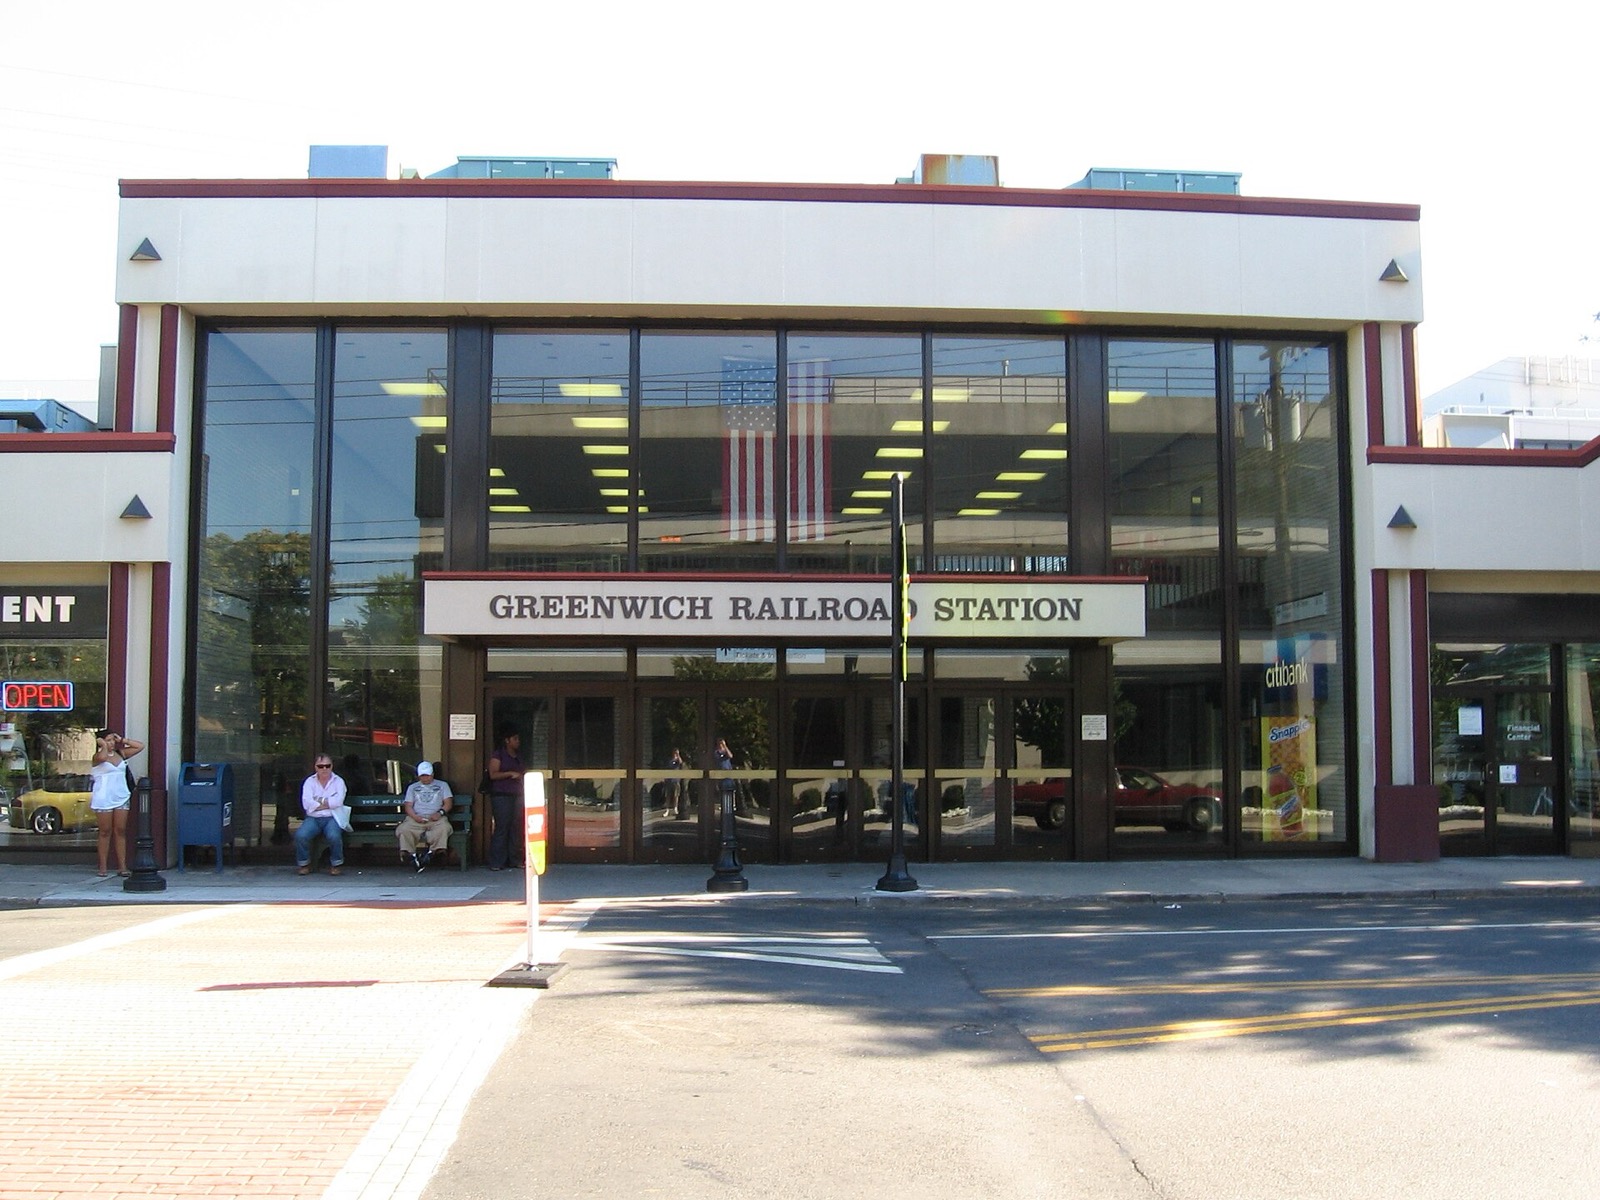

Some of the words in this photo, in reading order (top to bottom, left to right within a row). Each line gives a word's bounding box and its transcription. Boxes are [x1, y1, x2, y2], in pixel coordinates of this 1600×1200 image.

[2, 596, 76, 622] ENT
[489, 595, 713, 619] GREENWICH
[934, 598, 1083, 621] STATION
[1265, 657, 1308, 688] citibank
[5, 684, 70, 708] OPEN
[1270, 721, 1310, 741] Snapple
[1507, 724, 1541, 732] Financial
[1507, 733, 1532, 741] Center
